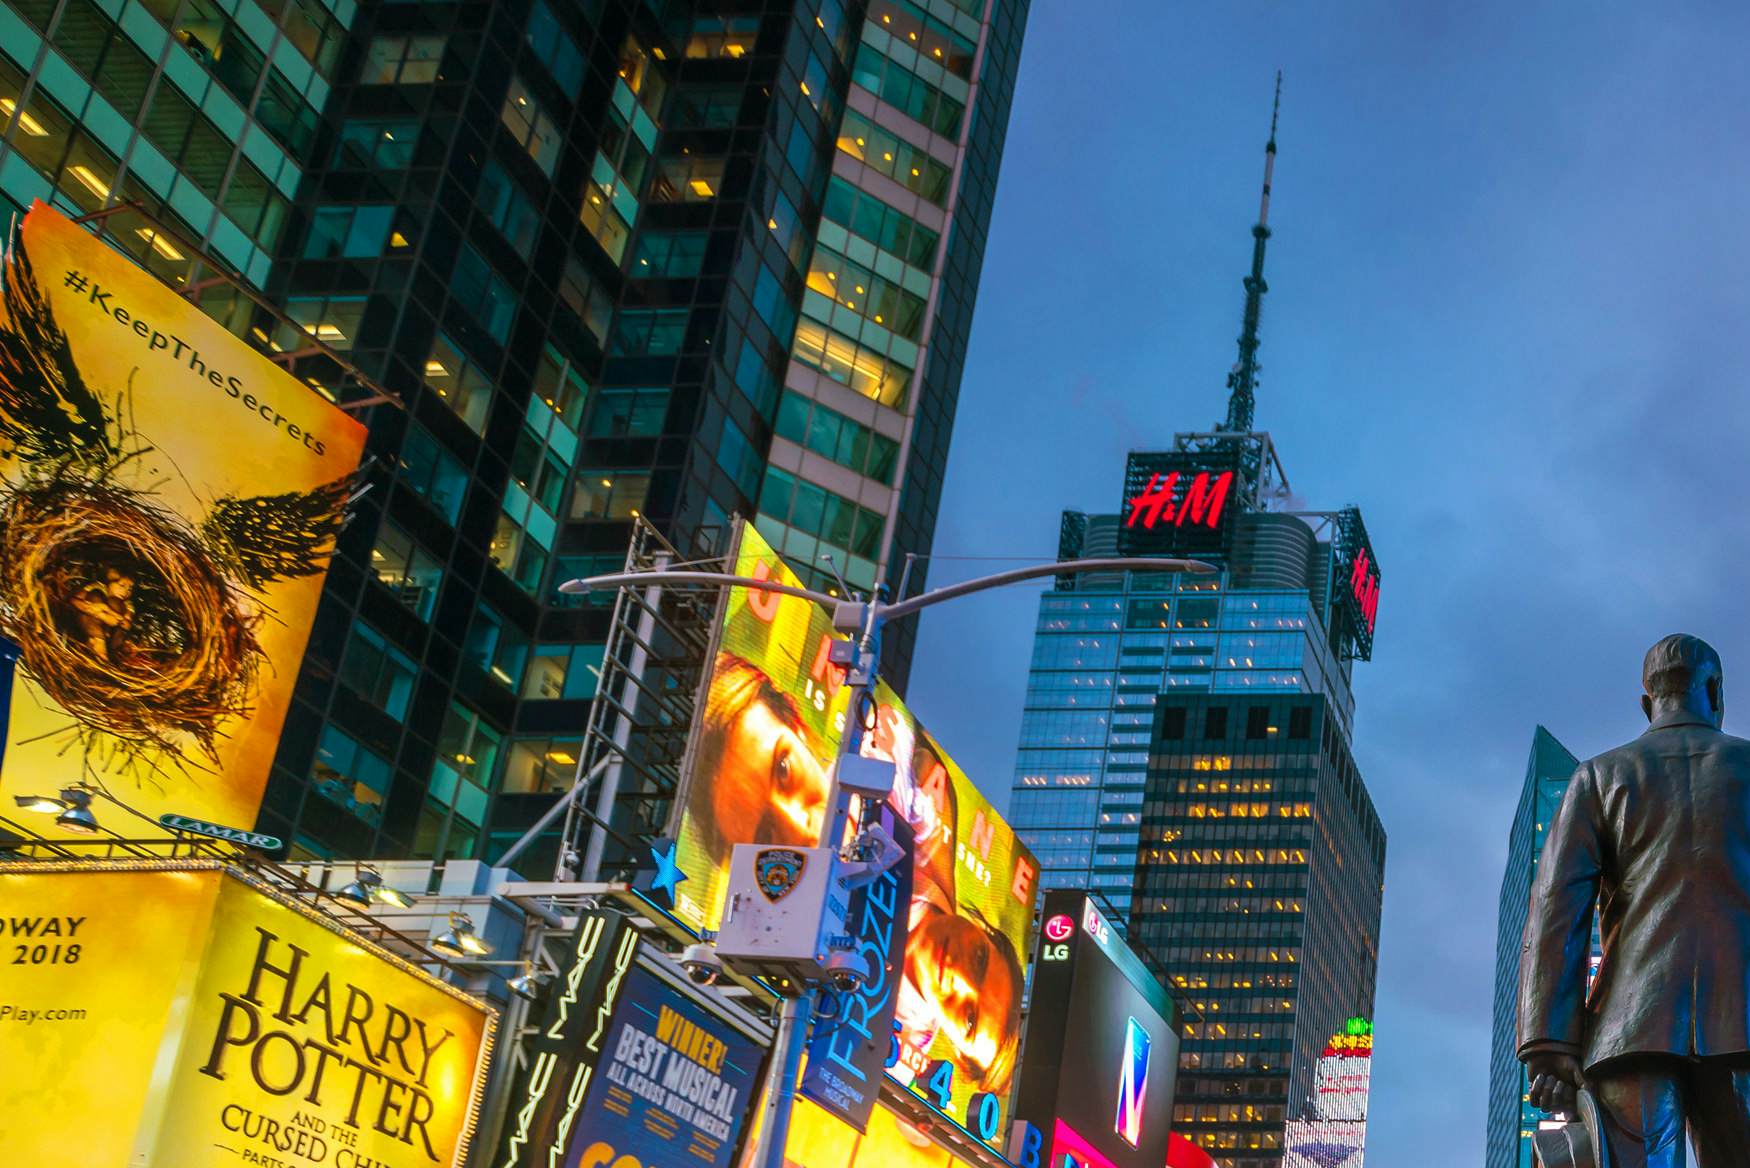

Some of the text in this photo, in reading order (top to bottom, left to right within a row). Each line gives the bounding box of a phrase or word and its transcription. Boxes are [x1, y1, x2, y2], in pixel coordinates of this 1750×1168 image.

[63, 270, 327, 457] #KeepTheSecrets
[1126, 471, 1234, 529] H&M
[170, 817, 270, 847] LAMAR
[11, 943, 83, 965] 2018
[1043, 944, 1070, 961] LG
[1096, 923, 1109, 945] LG
[826, 866, 898, 1082] FROZE
[239, 926, 455, 1089] HARRY
[655, 1004, 729, 1076] WINNER!
[198, 992, 441, 1162] POTTER
[606, 1061, 628, 1086] ALL
[614, 1022, 668, 1081] BEST
[661, 1052, 738, 1124] MUSICAL
[221, 1103, 327, 1165] CURSED
[291, 1111, 358, 1148] AND THE
